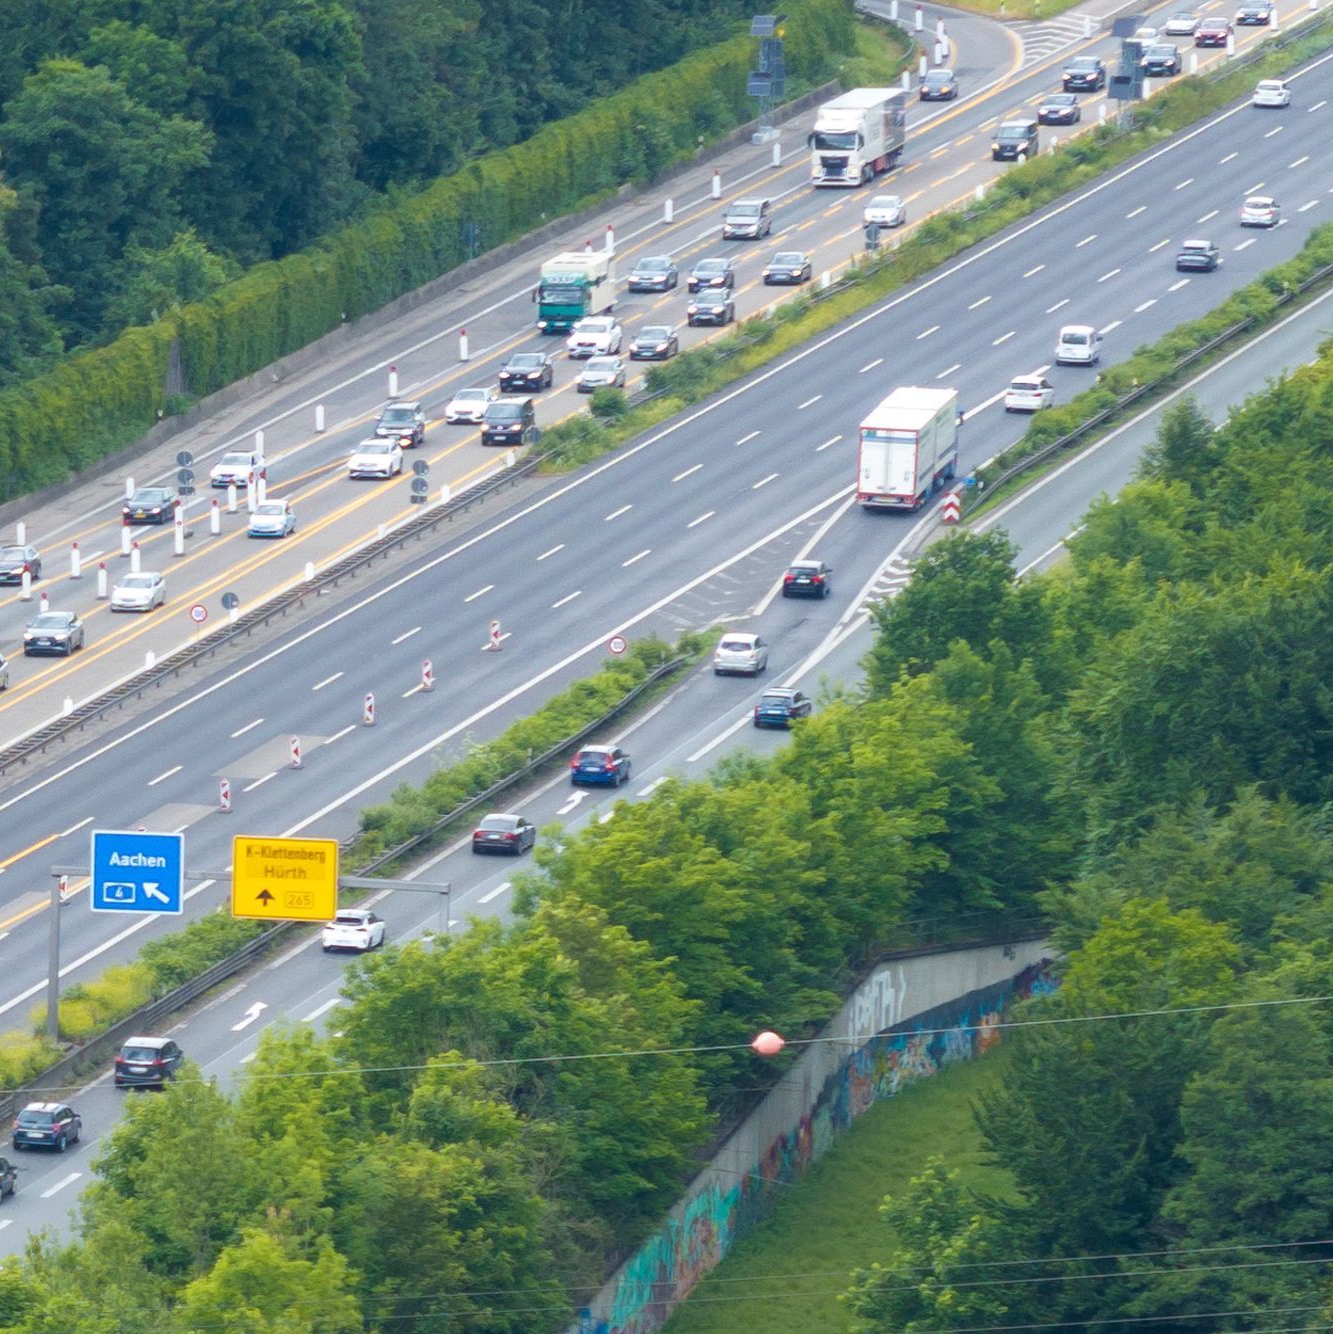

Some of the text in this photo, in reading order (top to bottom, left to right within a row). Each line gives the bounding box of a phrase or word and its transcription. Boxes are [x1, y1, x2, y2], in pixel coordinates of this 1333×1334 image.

[109, 851, 166, 868] Aachen
[264, 863, 307, 880] Hürth
[287, 893, 311, 906] 265
